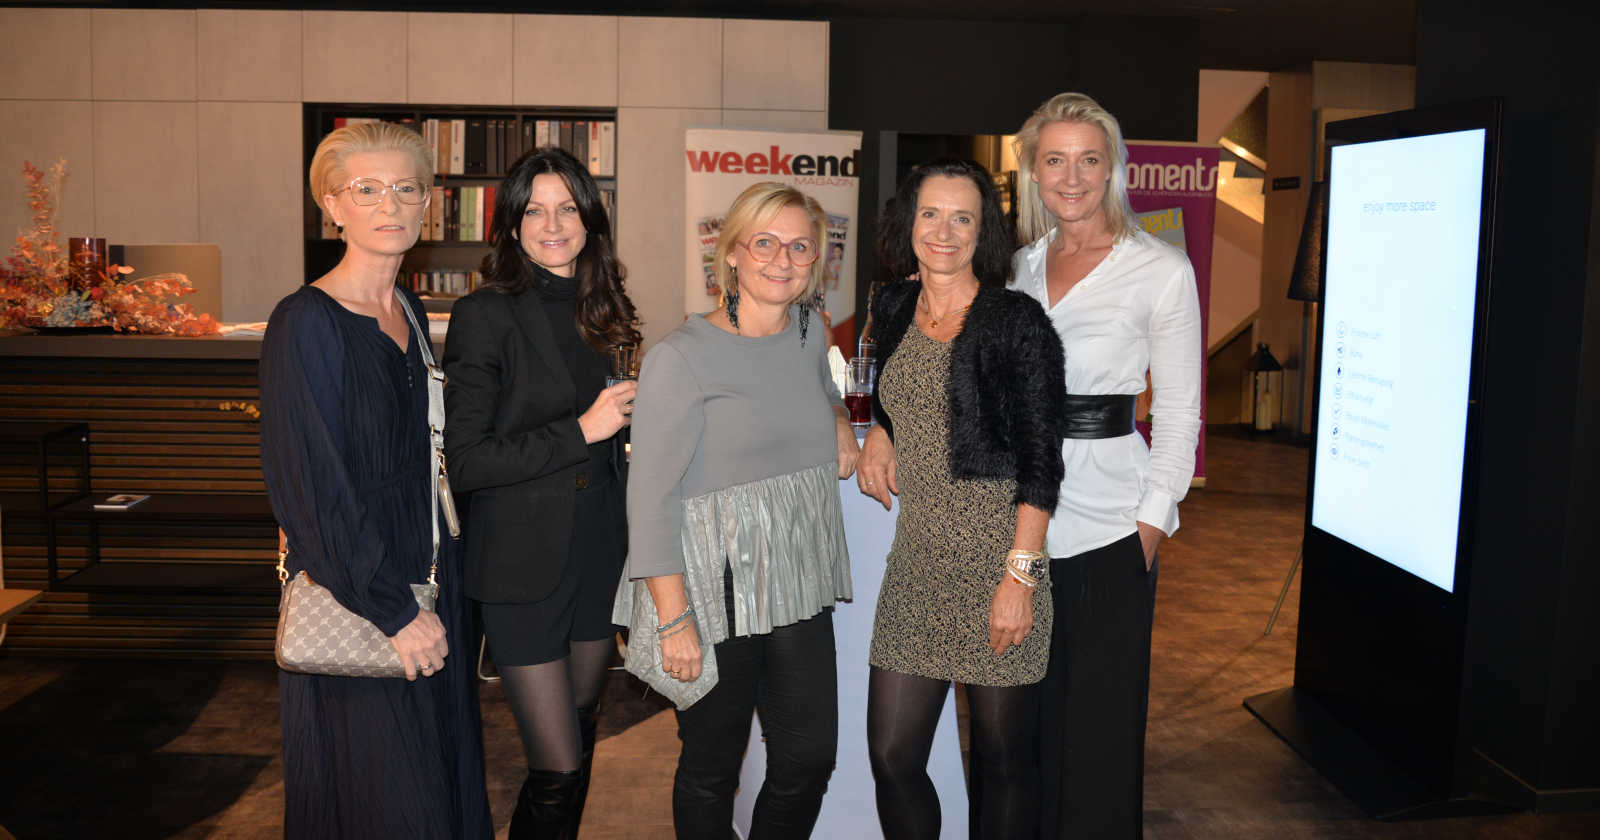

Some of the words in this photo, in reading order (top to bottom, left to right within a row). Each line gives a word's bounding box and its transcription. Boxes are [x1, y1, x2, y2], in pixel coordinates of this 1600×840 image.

[686, 145, 861, 176] weekend
[1386, 202, 1408, 212] more
[1410, 201, 1437, 214] space
